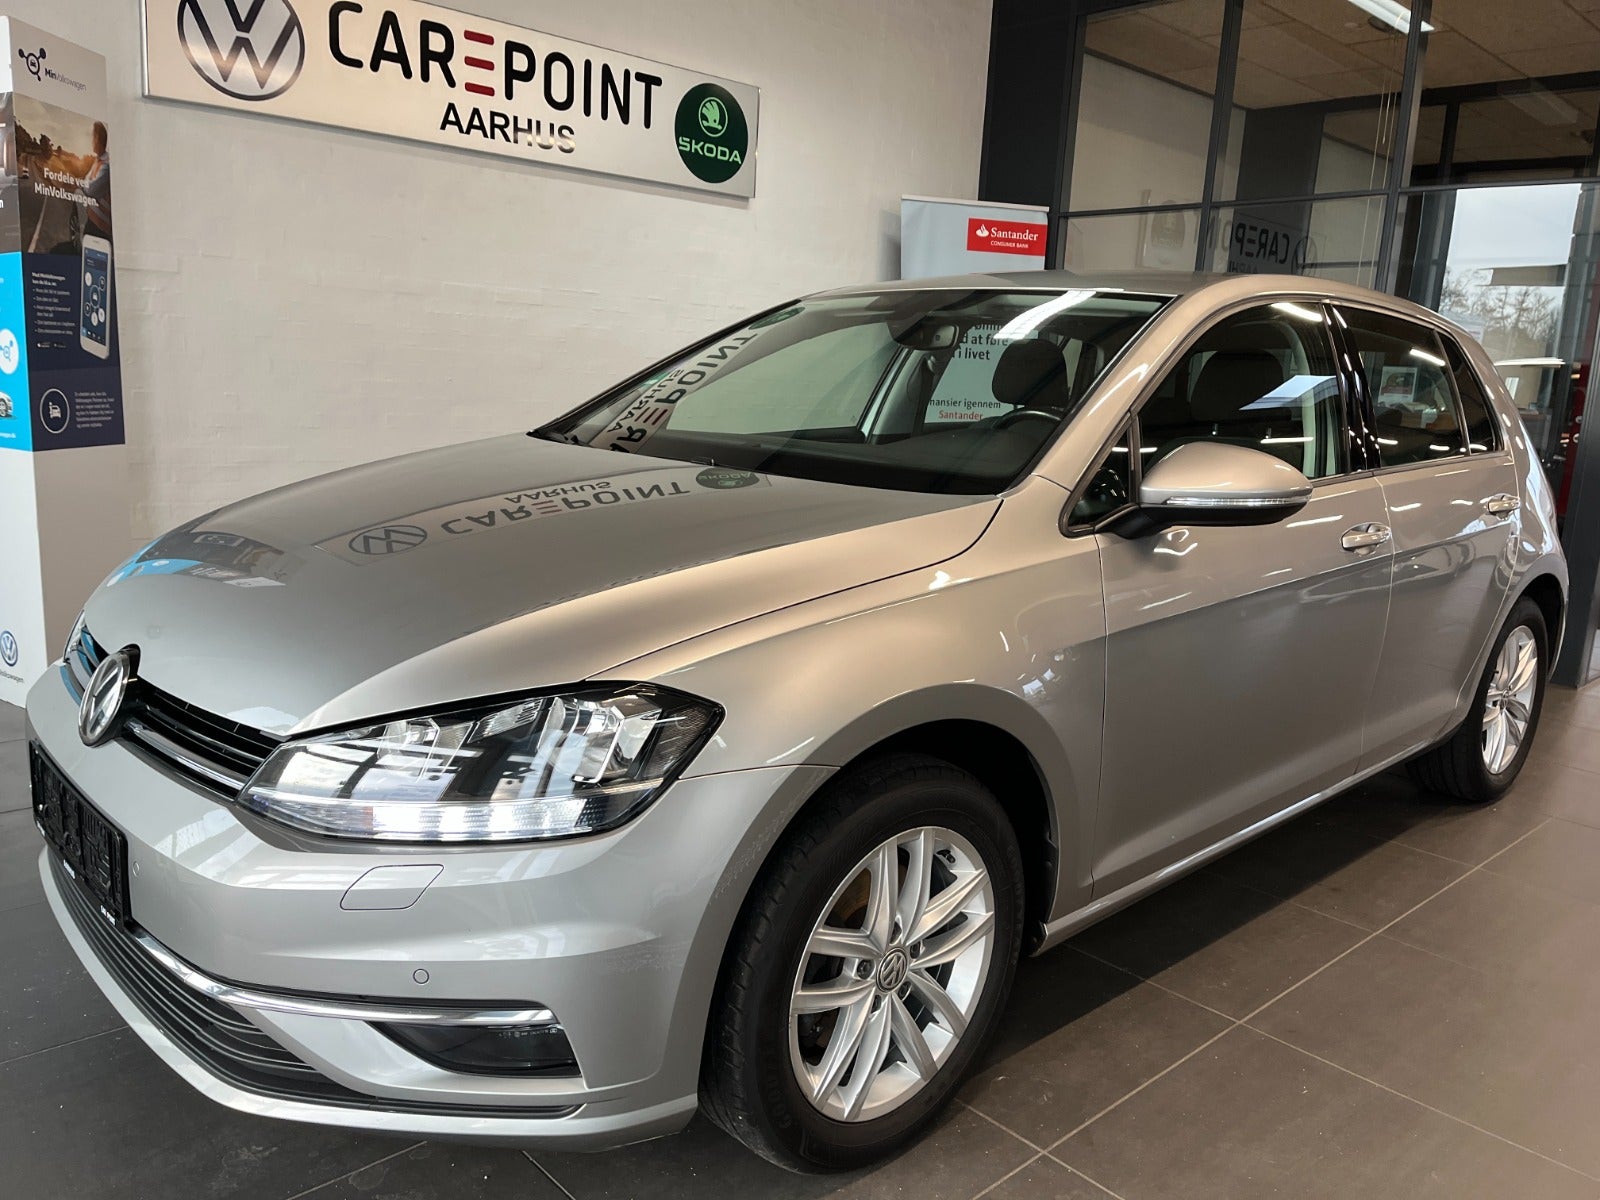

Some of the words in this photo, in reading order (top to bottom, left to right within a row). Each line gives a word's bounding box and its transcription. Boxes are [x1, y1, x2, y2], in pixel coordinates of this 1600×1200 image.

[328, 1, 663, 129] CAREPOINT
[440, 101, 576, 154] AARHUS
[44, 167, 75, 185] Fordele
[991, 227, 1039, 241] Santander
[990, 240, 1016, 248] CONSUMER
[971, 336, 984, 345] at
[964, 347, 991, 360] livet
[928, 398, 962, 408] nansier
[963, 399, 1002, 411] igennem
[938, 410, 984, 421] Santander
